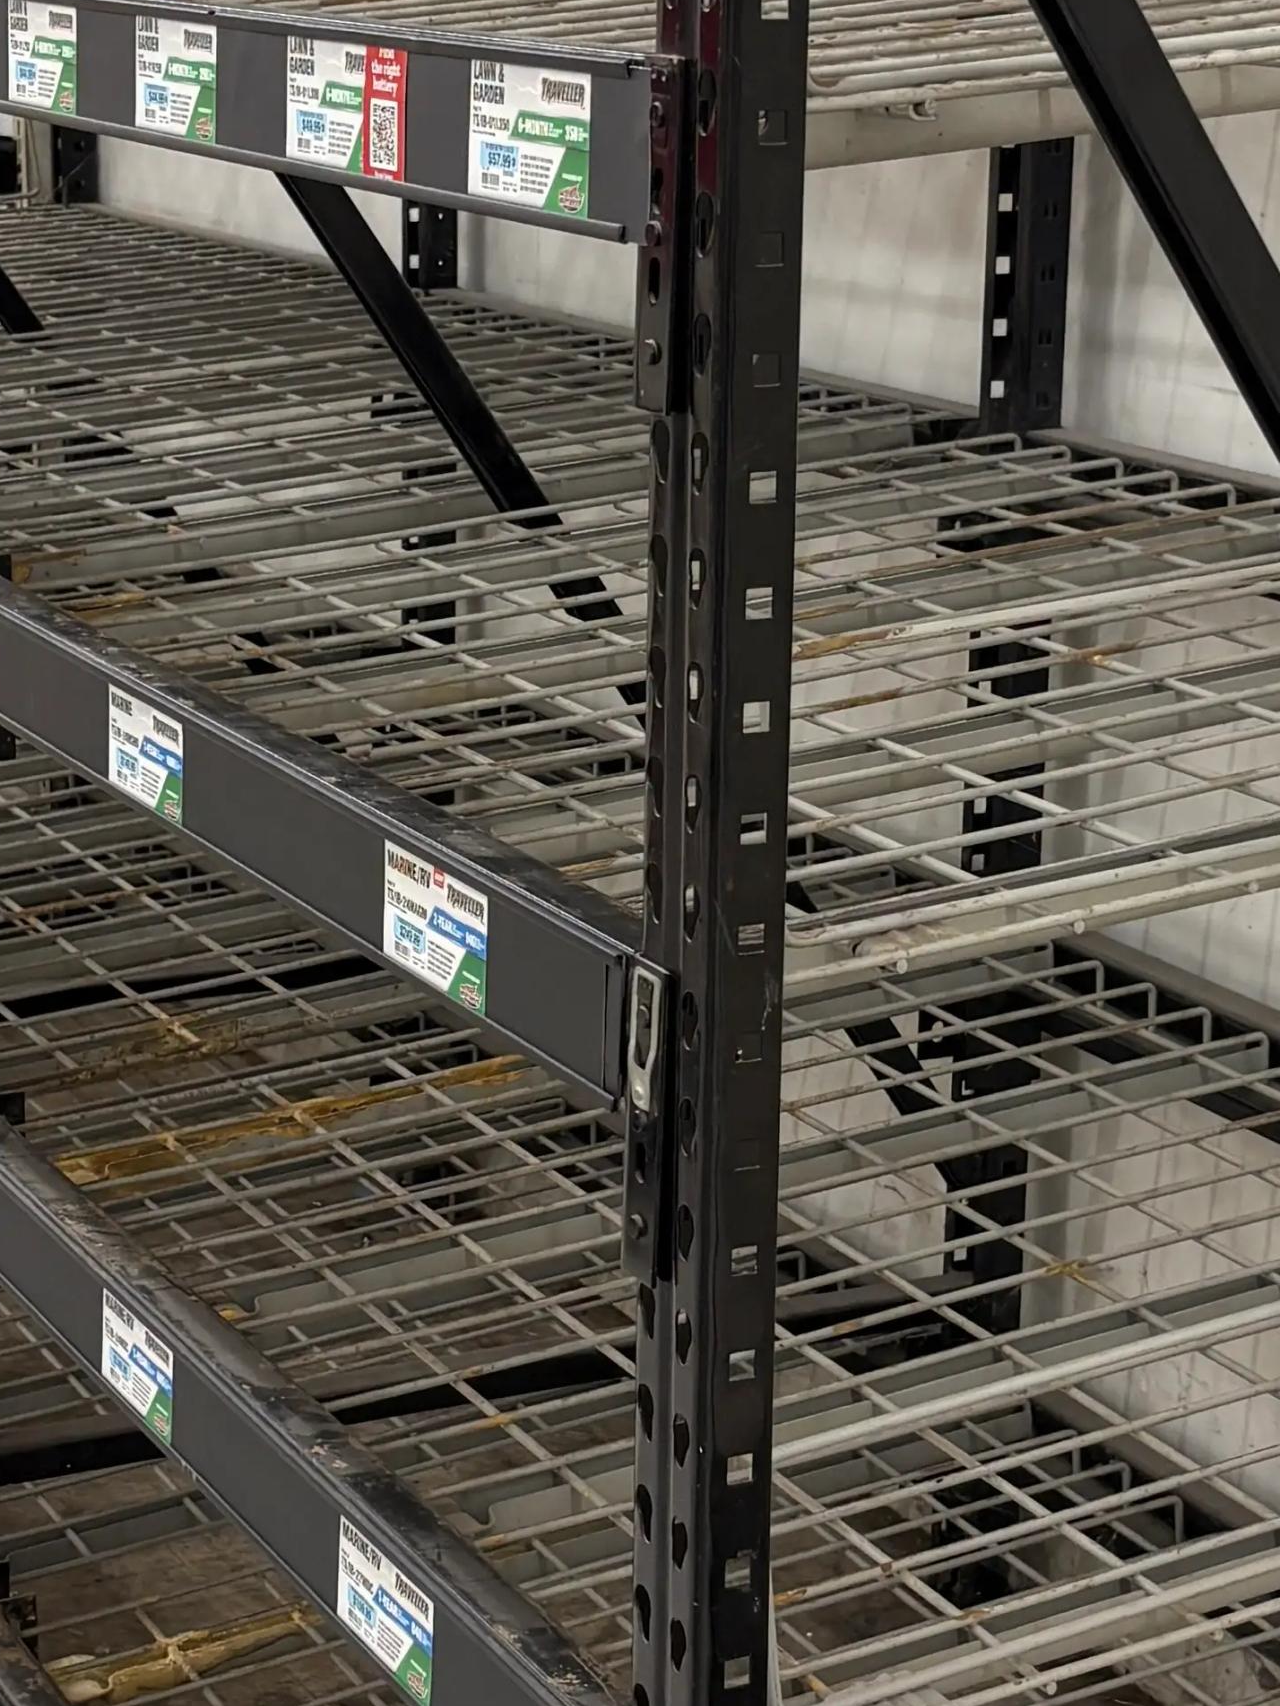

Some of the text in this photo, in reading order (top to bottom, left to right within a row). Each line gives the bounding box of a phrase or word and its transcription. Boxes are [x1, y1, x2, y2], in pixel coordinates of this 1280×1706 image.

[371, 58, 401, 80] the right
[474, 61, 504, 82] LAWN &
[373, 74, 398, 98] battery
[473, 82, 504, 105] GARDEN
[541, 77, 586, 109] TRAVELLER
[387, 849, 431, 889] MARINE/RV
[446, 883, 486, 925] TRAVELLER
[395, 1572, 430, 1623] TRAVELLER
